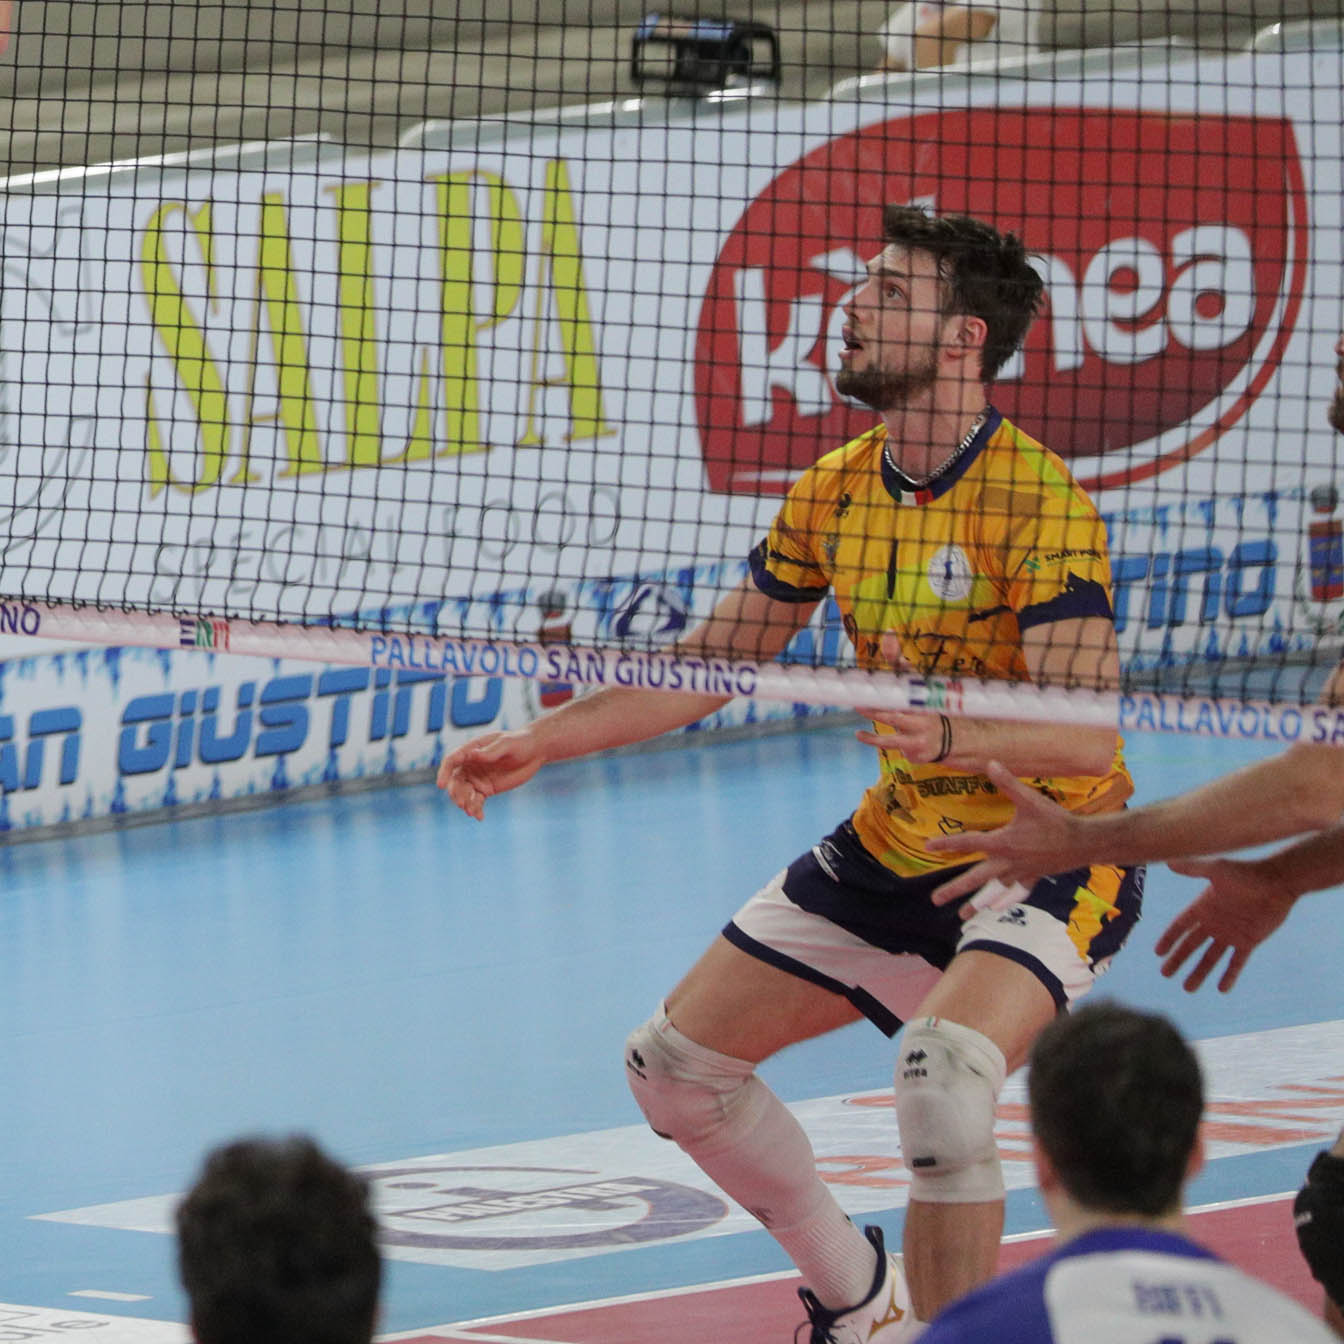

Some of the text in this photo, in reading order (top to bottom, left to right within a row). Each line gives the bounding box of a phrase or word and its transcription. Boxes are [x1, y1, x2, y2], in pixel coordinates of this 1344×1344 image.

[141, 156, 619, 502] SALPA
[370, 635, 539, 678] PALLAVOLO
[546, 648, 606, 686] SAN
[614, 654, 758, 698] GIUSTINO
[1118, 695, 1303, 742] PALLAVOLO
